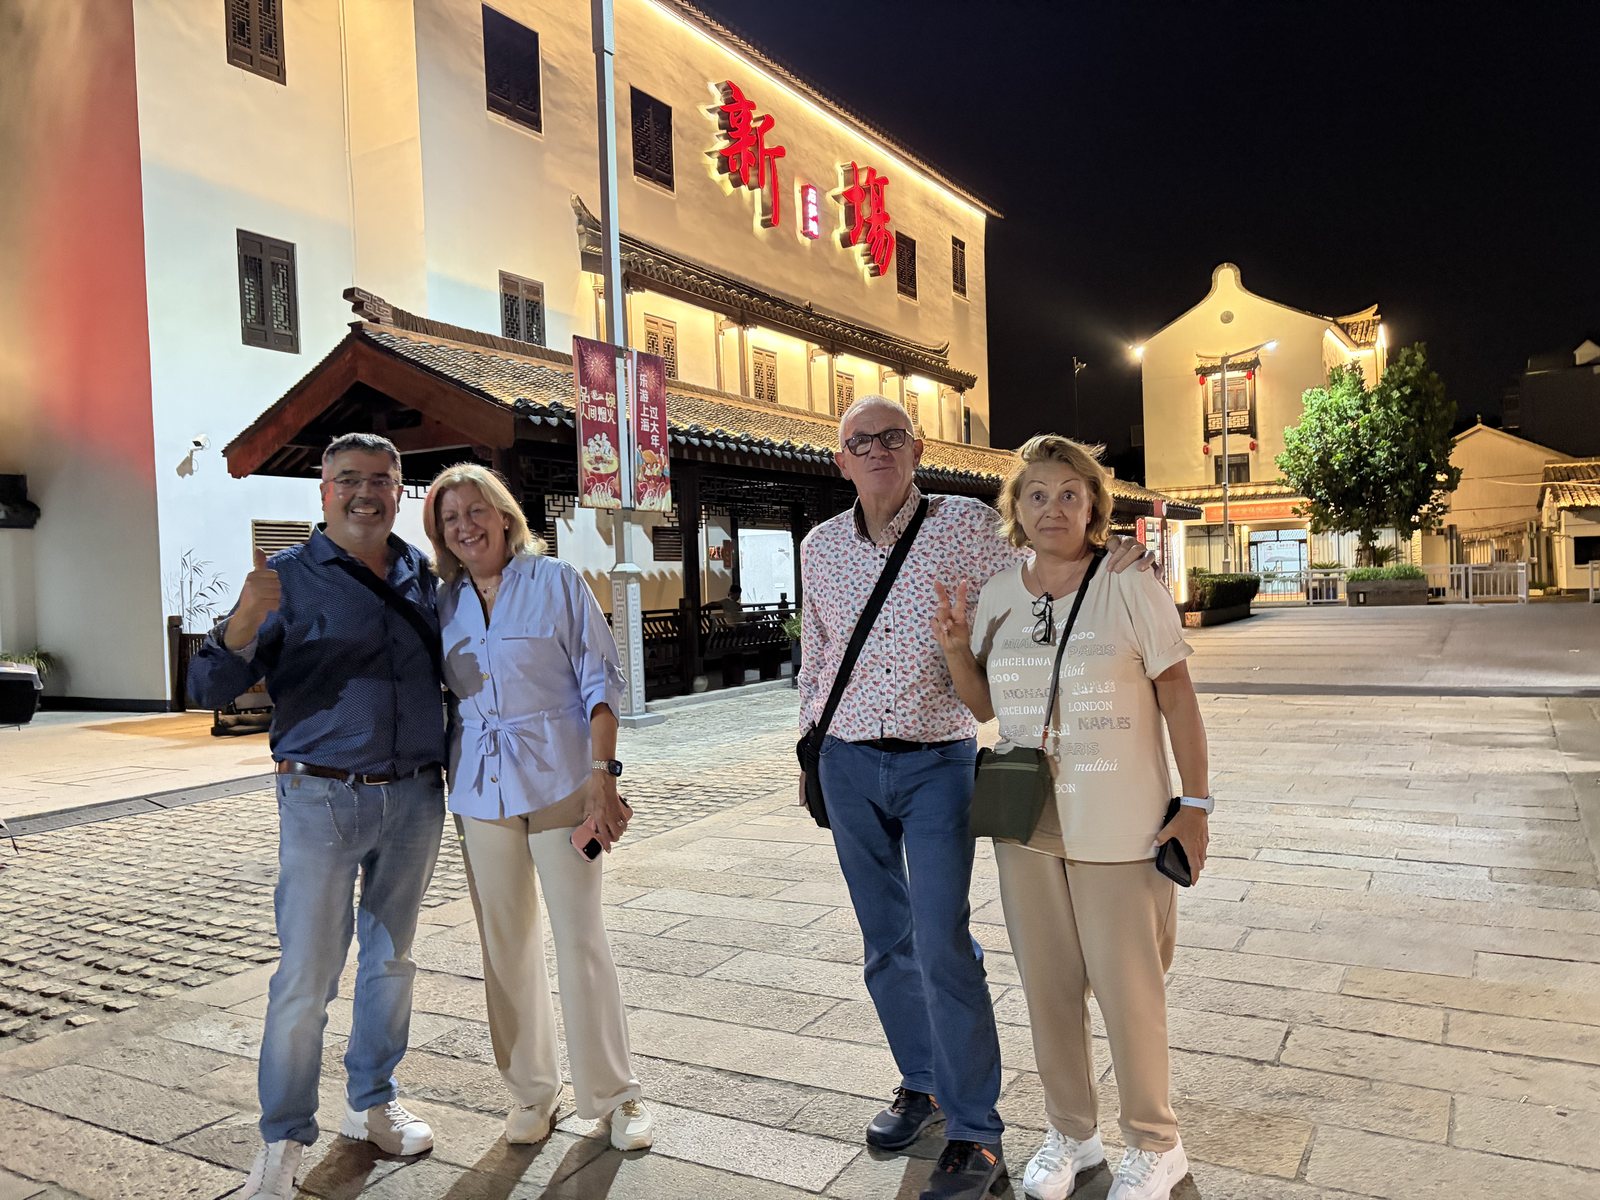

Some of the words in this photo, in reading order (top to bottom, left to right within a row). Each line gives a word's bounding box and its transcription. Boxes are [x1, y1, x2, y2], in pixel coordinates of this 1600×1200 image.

[640, 374, 650, 432] 乐游上海
[650, 406, 661, 448] 过大年
[998, 705, 1046, 716] ARCELONA
[1067, 700, 1113, 712] LONDON
[1078, 716, 1131, 730] NAPLES
[1074, 757, 1119, 772] malibú
